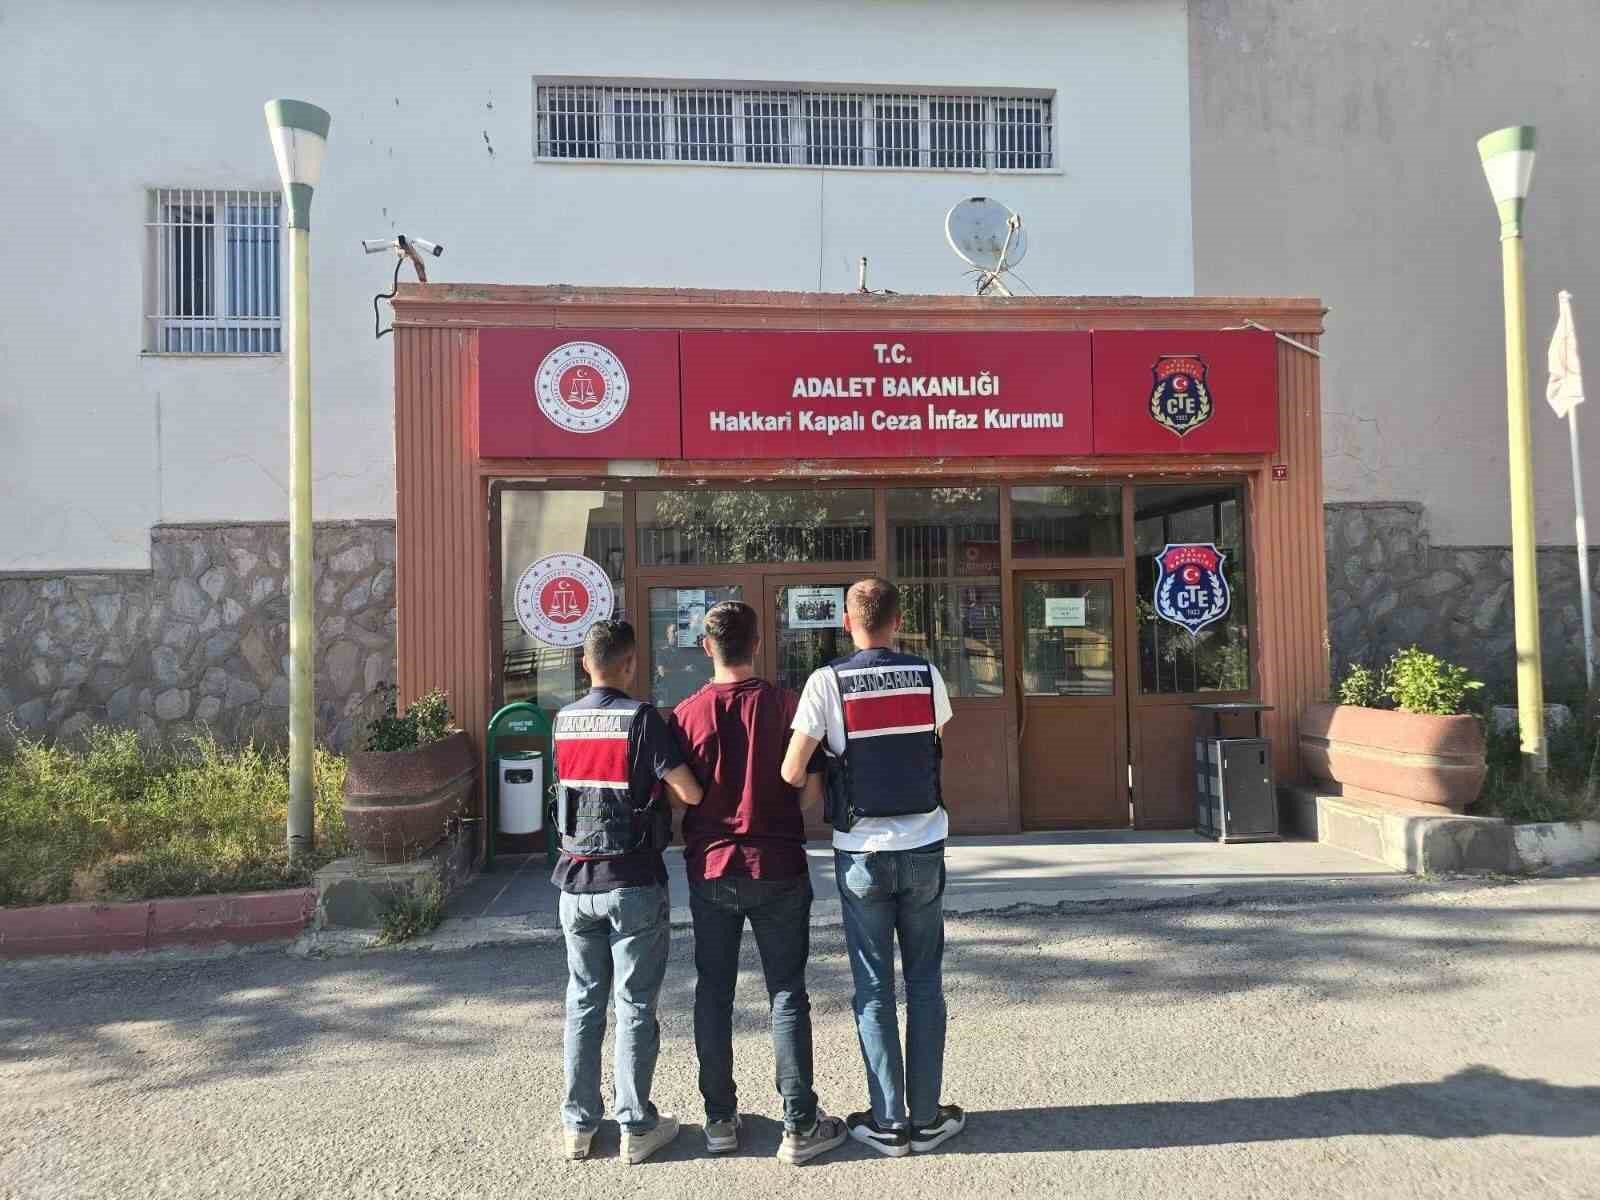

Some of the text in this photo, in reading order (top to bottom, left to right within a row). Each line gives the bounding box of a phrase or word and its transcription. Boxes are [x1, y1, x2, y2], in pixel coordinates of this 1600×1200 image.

[873, 343, 912, 364] T.C.
[792, 370, 999, 398] ADALET BAKANLIĞI
[710, 404, 1064, 436] Hakkari Kapalı Ceza İnfaz Kurumu
[849, 671, 924, 692] JANDARMA
